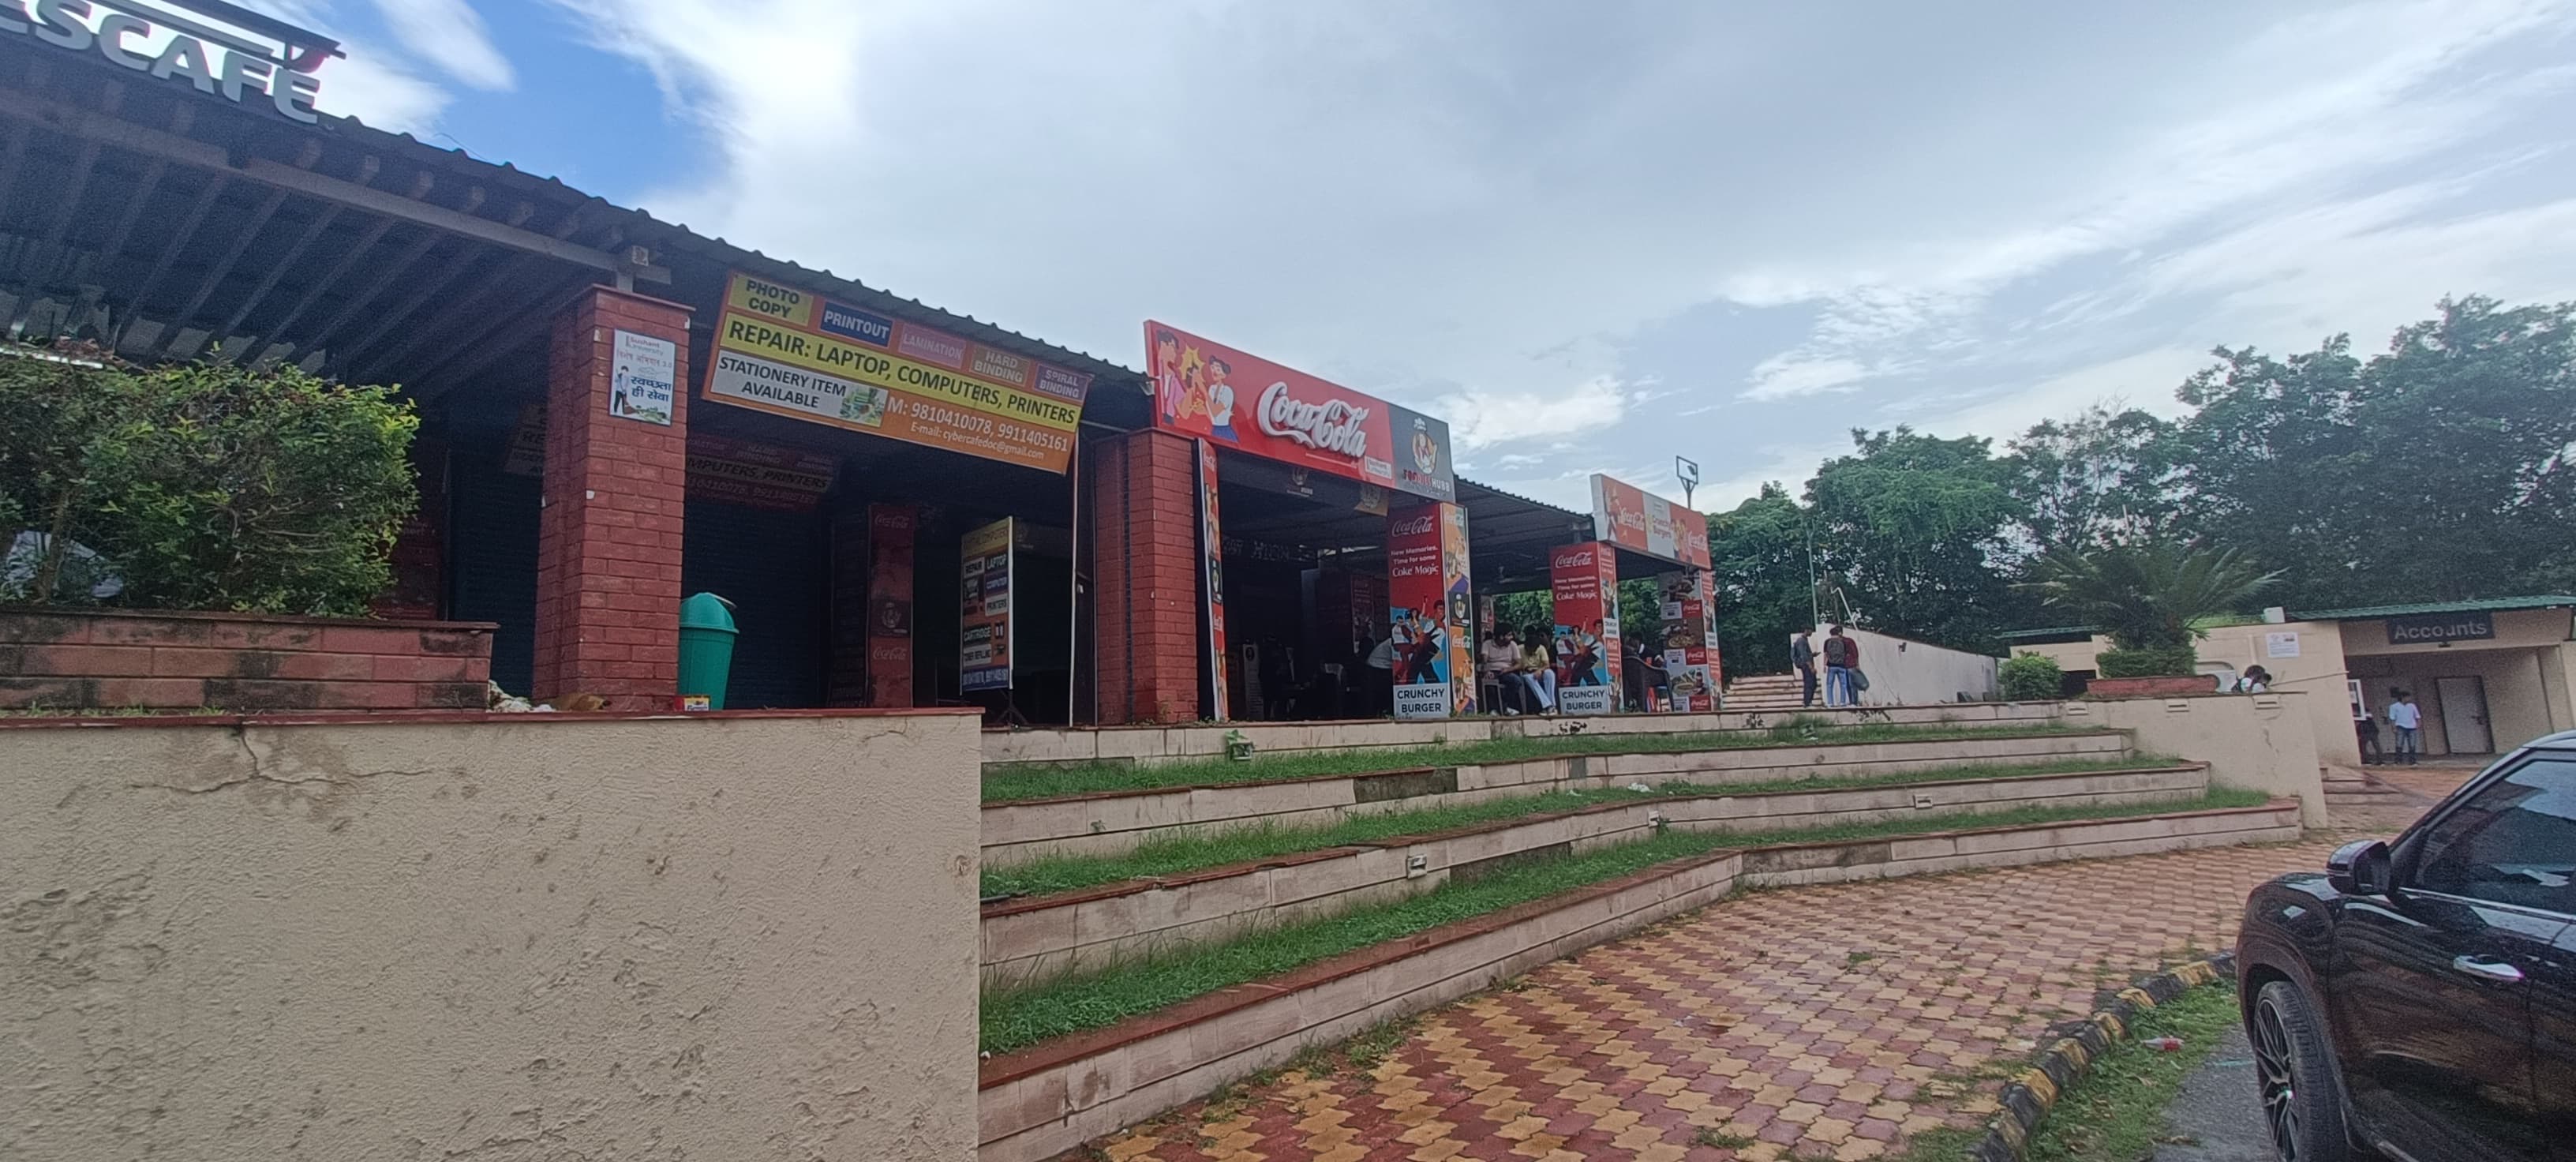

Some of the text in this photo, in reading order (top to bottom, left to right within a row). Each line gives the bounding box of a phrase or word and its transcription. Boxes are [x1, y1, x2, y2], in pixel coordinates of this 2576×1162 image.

[746, 279, 800, 305] PHOTO
[748, 297, 792, 319] COPY
[823, 309, 890, 339] PRINTOUT
[903, 333, 964, 361] LAMINATION
[985, 351, 1019, 369] HARD
[719, 357, 847, 397] STATIONERY ITEM
[728, 320, 1076, 425] REPAIR: LAPTOP, COMPUTERS, PRINTERS
[974, 360, 1024, 384] BINDING
[1045, 369, 1079, 387] SPIRAL
[631, 376, 672, 391] स्वच्छता
[631, 385, 669, 402] ही सेवा
[1039, 379, 1080, 399] BINDING
[741, 381, 820, 408] AVAILABLE
[887, 397, 1068, 452] M: 9810410078, 9911405161
[911, 421, 1044, 459] E-mail: cybercafedoc@gmail.com
[687, 458, 828, 489] MPUTERS, PRINTERS
[1392, 563, 1439, 577] Coke Magic
[2394, 620, 2488, 640] Accounts
[1397, 688, 1445, 699] CRUNCHY
[1563, 690, 1605, 699] CRUNCHY
[1401, 703, 1441, 713] BURGER
[1566, 701, 1603, 710] BURGER
